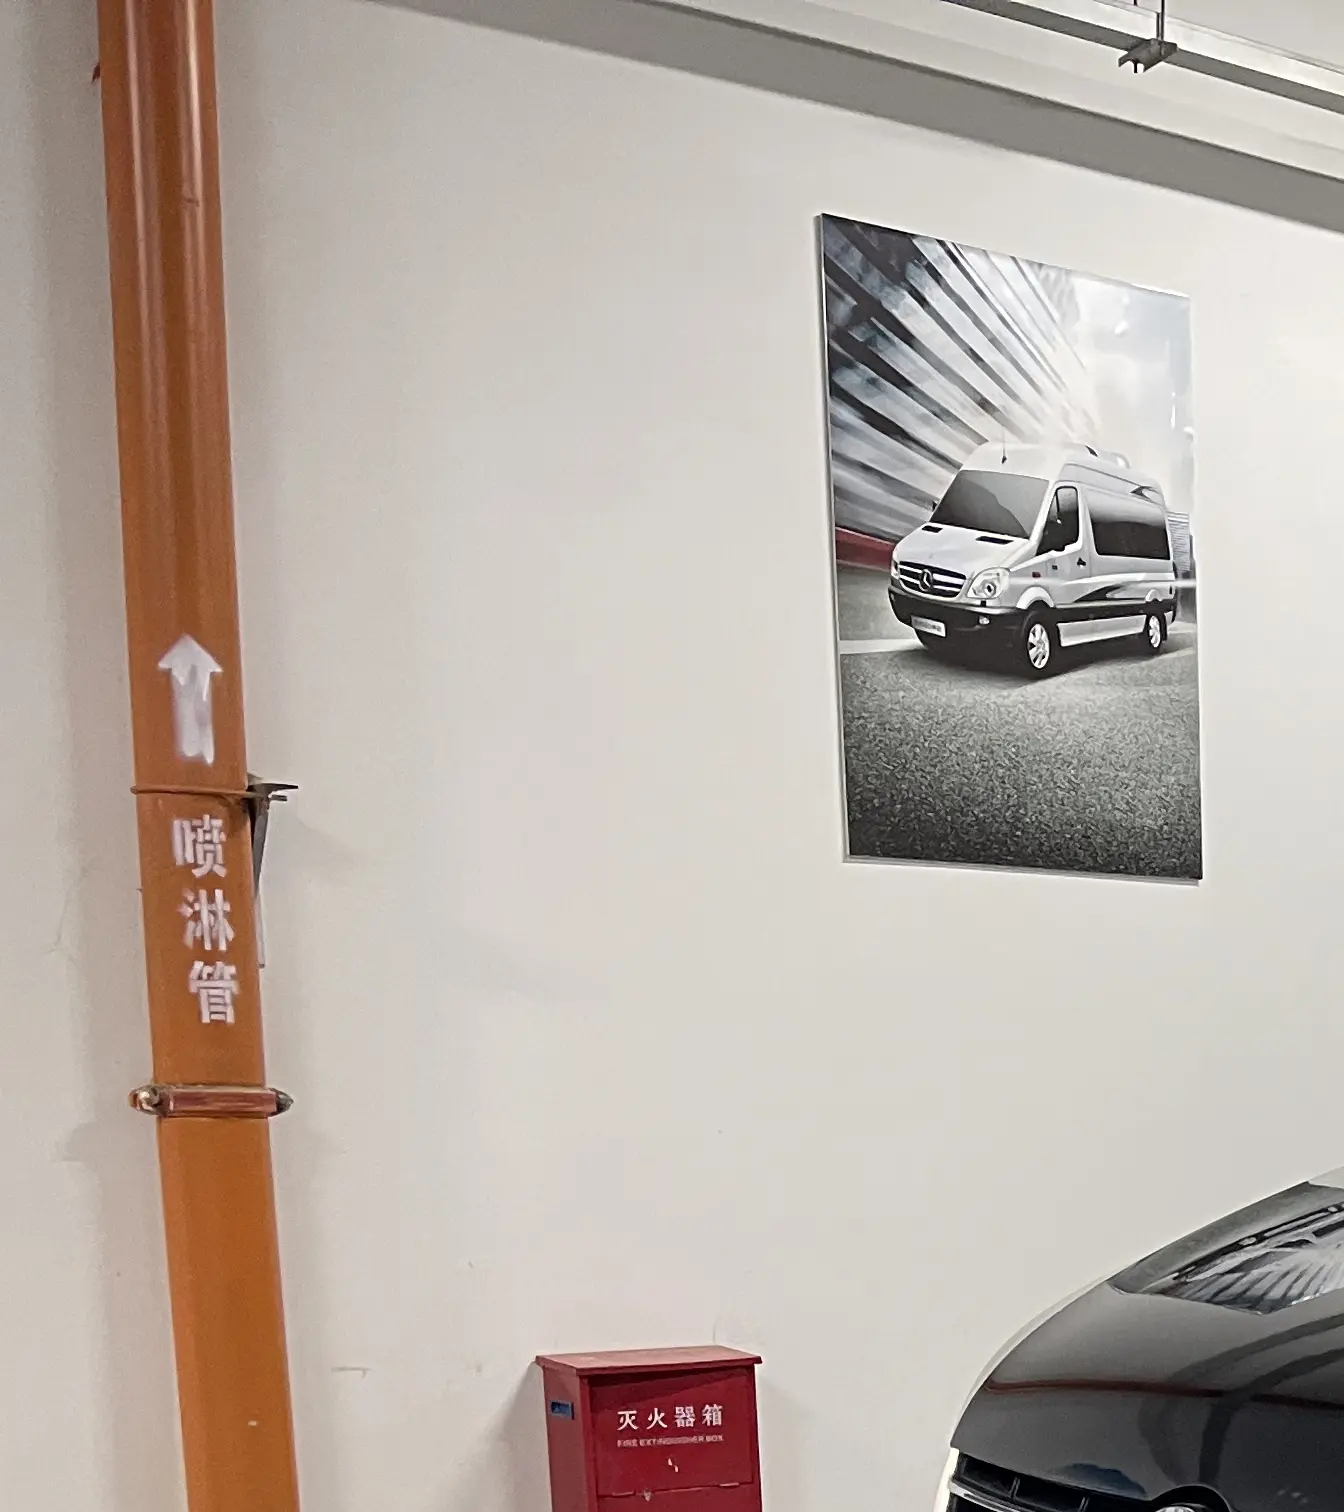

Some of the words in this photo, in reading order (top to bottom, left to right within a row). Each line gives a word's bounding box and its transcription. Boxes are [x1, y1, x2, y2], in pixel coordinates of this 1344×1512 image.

[172, 813, 240, 1024] 喷淋管
[616, 1403, 723, 1431] 灭火器箱
[616, 1438, 638, 1448] FIRE
[705, 1434, 724, 1442] BOX
